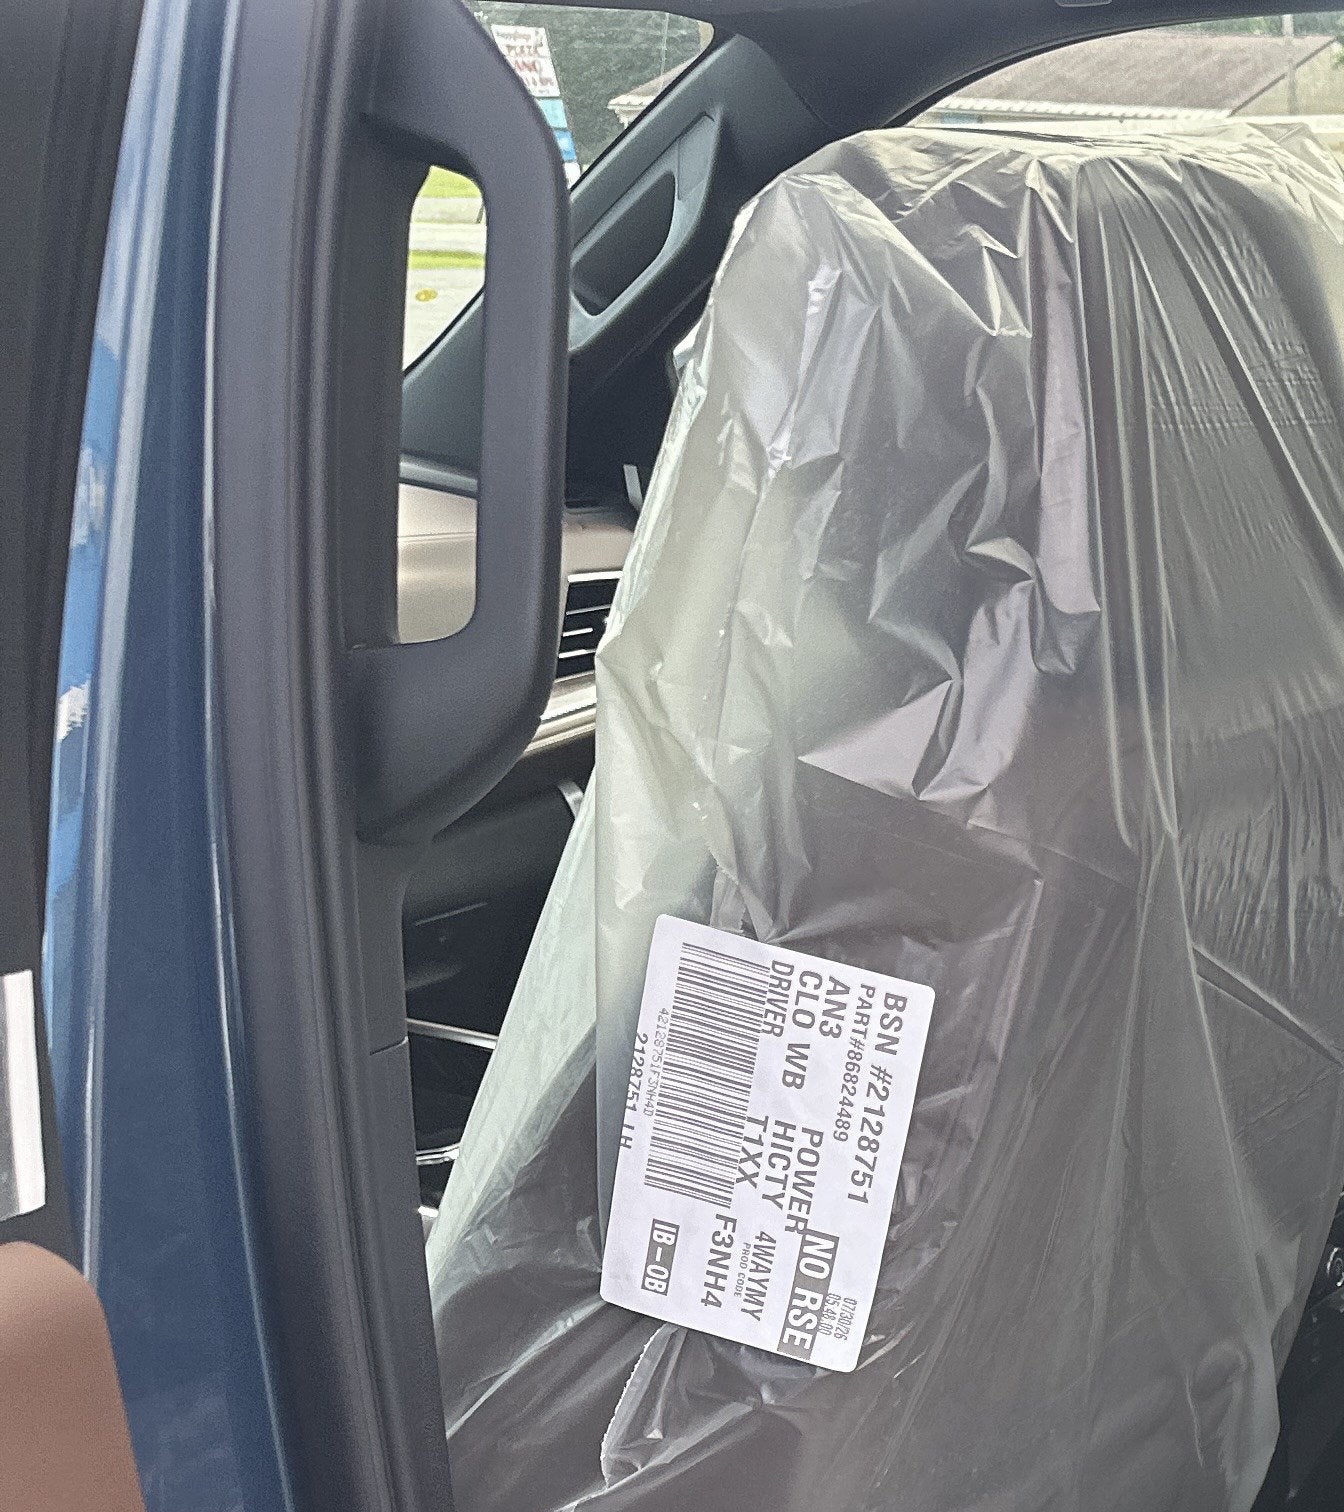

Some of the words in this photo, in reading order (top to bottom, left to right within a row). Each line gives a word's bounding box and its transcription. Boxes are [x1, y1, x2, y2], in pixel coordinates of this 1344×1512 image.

[761, 959, 794, 1038] DRIVER
[791, 970, 823, 1029] CLO
[818, 975, 850, 1038] AN3
[874, 992, 907, 1055] BSN
[781, 1043, 810, 1089] WB
[832, 983, 876, 1142] PART#86824489
[735, 1115, 769, 1189] T1XX
[761, 1119, 796, 1210] HICTY
[847, 1064, 892, 1204] #2128751
[784, 1126, 824, 1235] POWER
[700, 1213, 738, 1308] F3NH4
[733, 1272, 746, 1298] CODE
[739, 1242, 752, 1270] PROD
[740, 1230, 777, 1322] 4WAYMY
[799, 1234, 836, 1280] NO
[782, 1286, 824, 1350] RSE
[834, 1297, 858, 1341] 07/30/26
